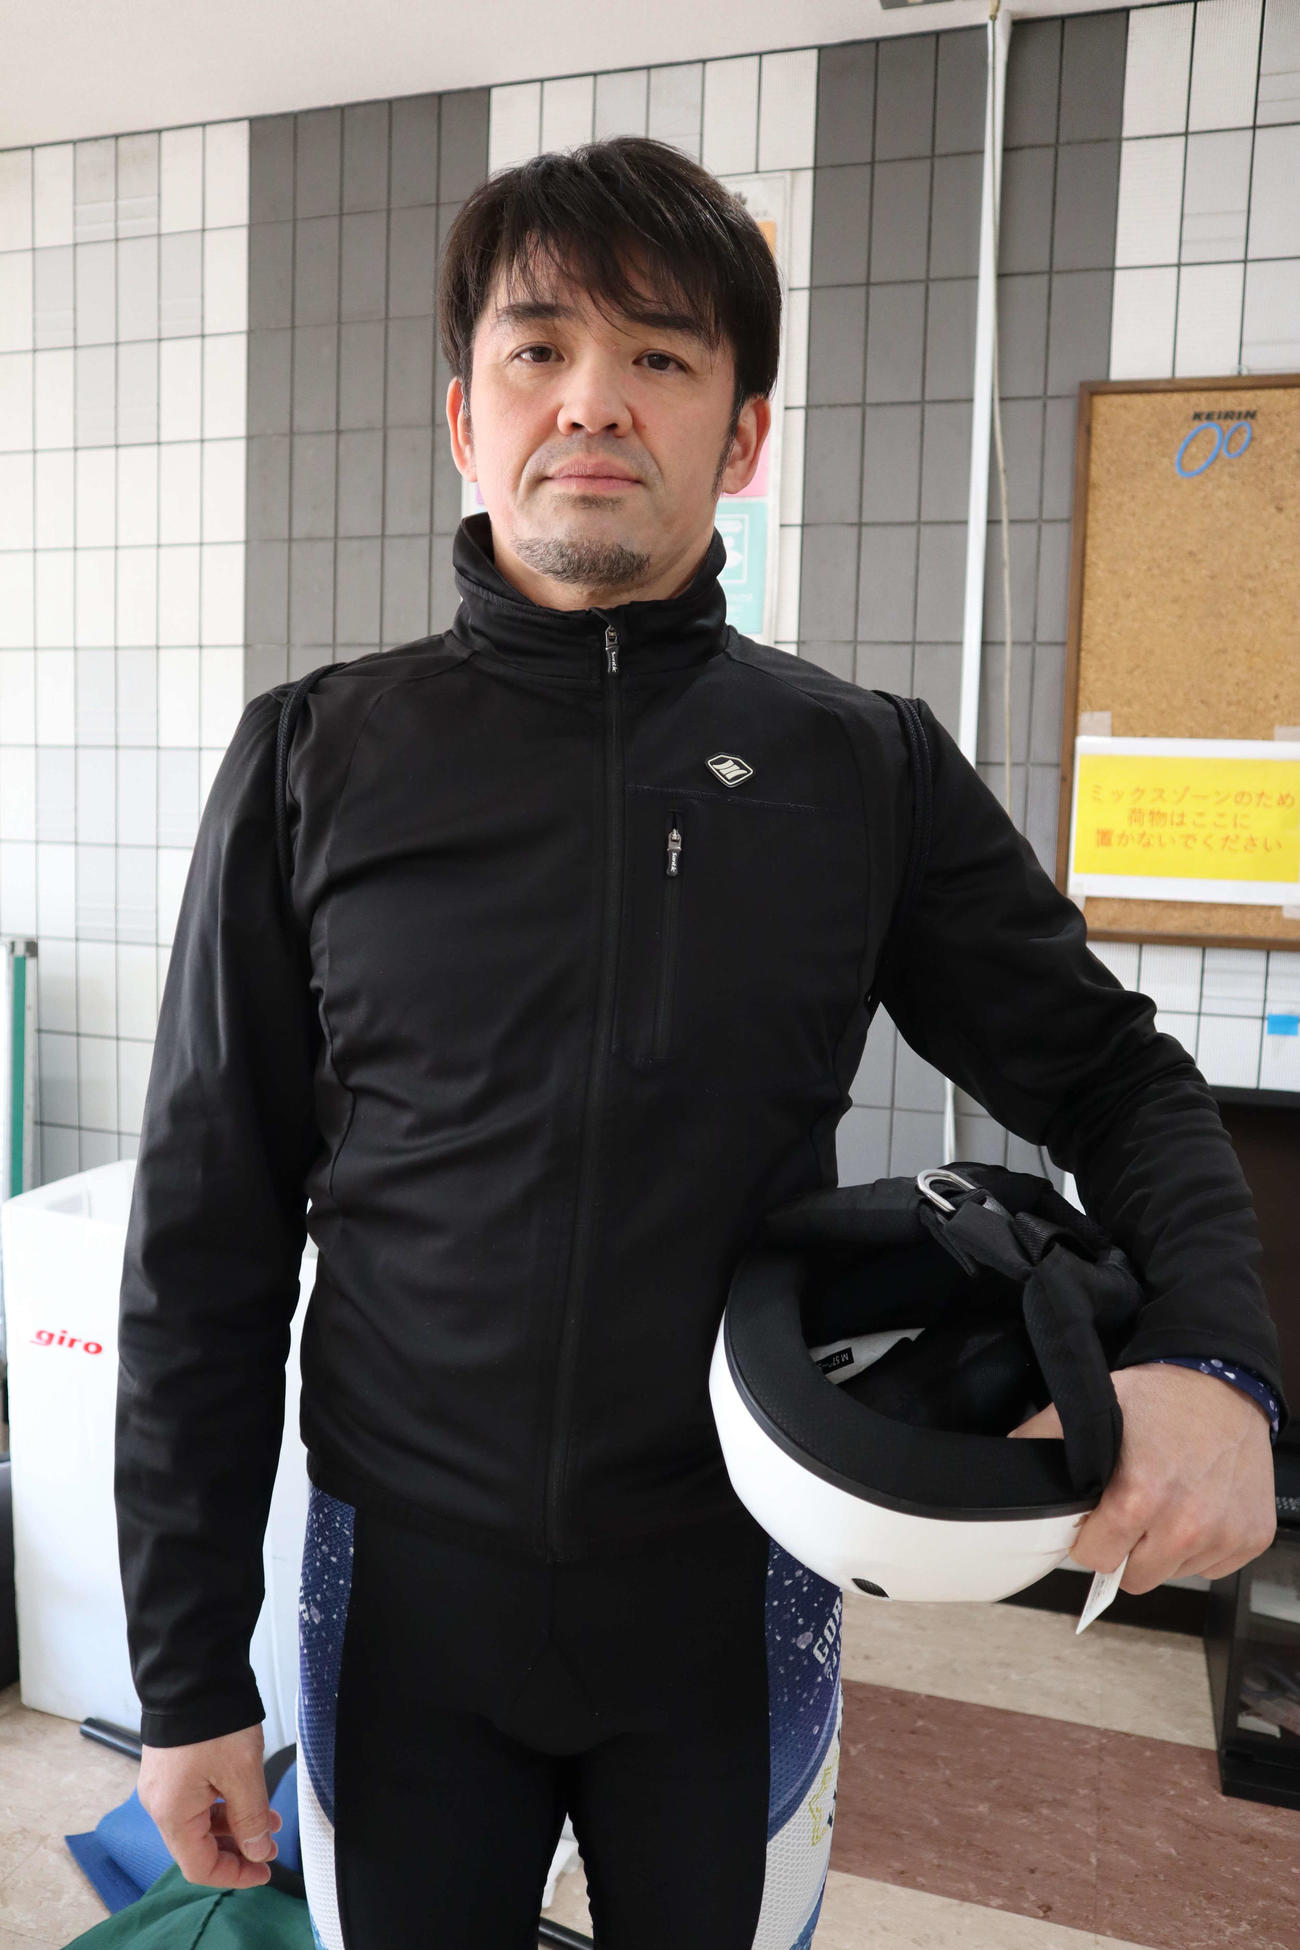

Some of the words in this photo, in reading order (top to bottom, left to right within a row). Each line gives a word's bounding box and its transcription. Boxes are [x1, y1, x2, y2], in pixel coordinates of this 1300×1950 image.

[1192, 410, 1257, 421] KEIRIN
[1092, 784, 1296, 809] ミックスゾーンのため
[1128, 807, 1250, 829] 荷物はここに
[1096, 827, 1283, 853] 置かないでください
[29, 1329, 103, 1354] giro
